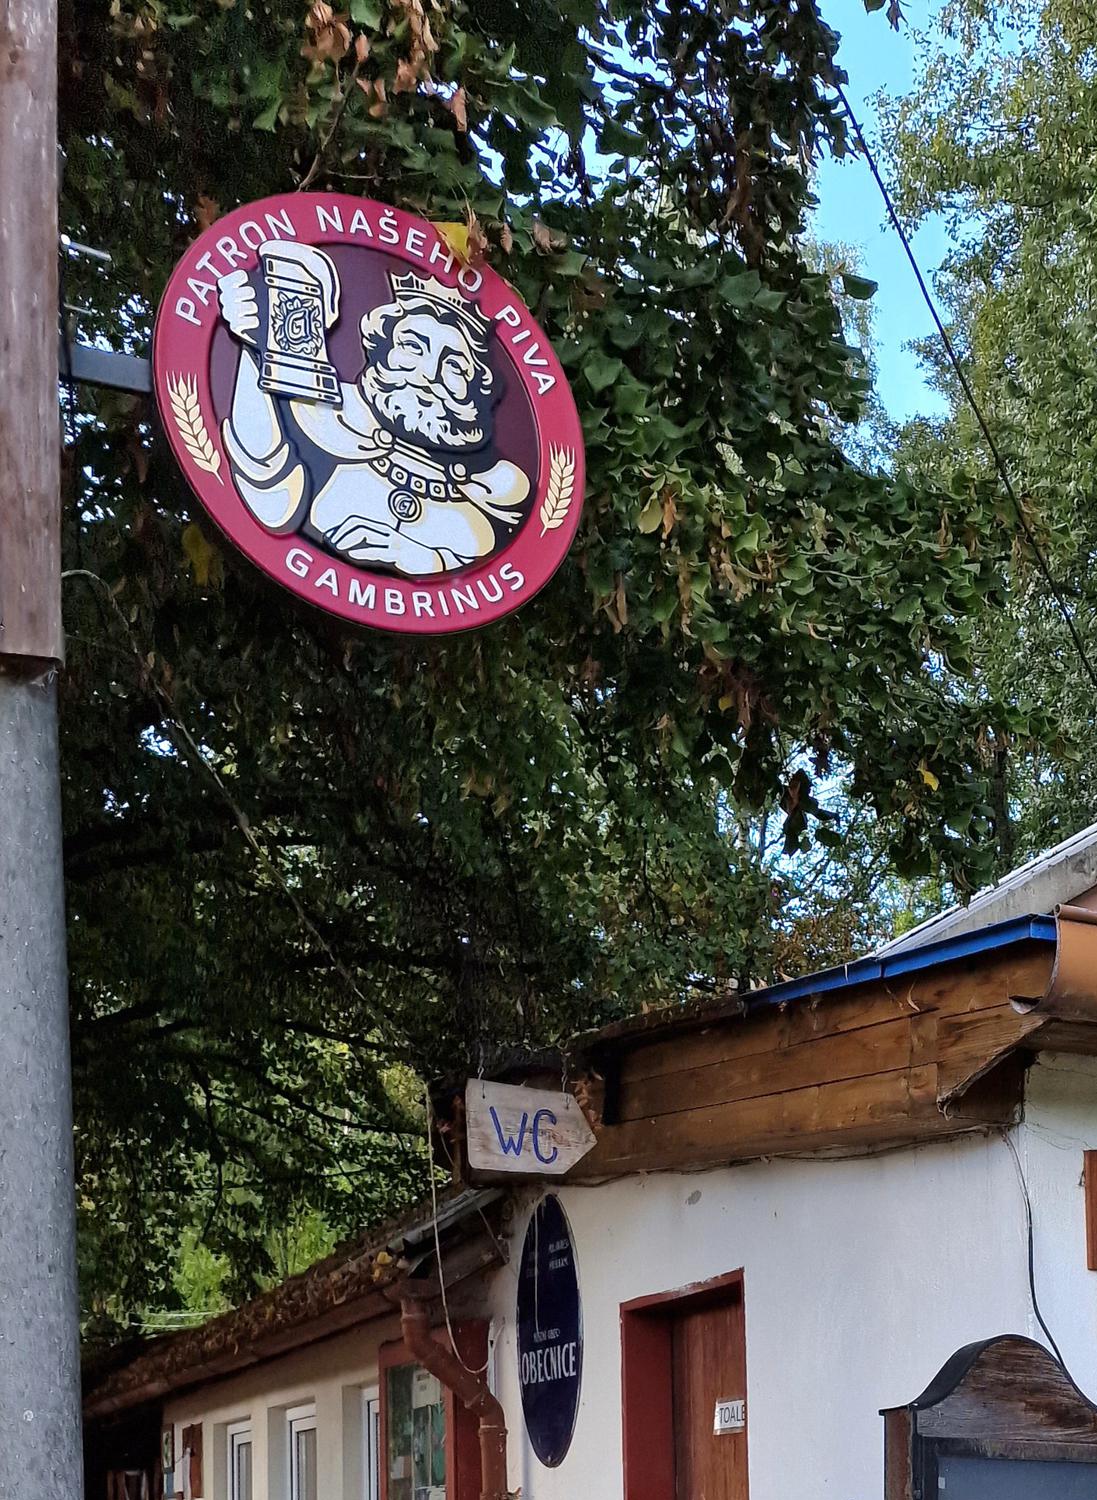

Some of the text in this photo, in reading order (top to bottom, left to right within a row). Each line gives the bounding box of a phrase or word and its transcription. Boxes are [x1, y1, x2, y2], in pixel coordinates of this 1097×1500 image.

[175, 204, 557, 396] PATRON NAŠEHO PIVA
[284, 547, 525, 618] GAMBRINUS
[489, 1104, 558, 1165] WC
[521, 1342, 577, 1385] OBECNICE
[719, 1404, 745, 1424] TOALE
